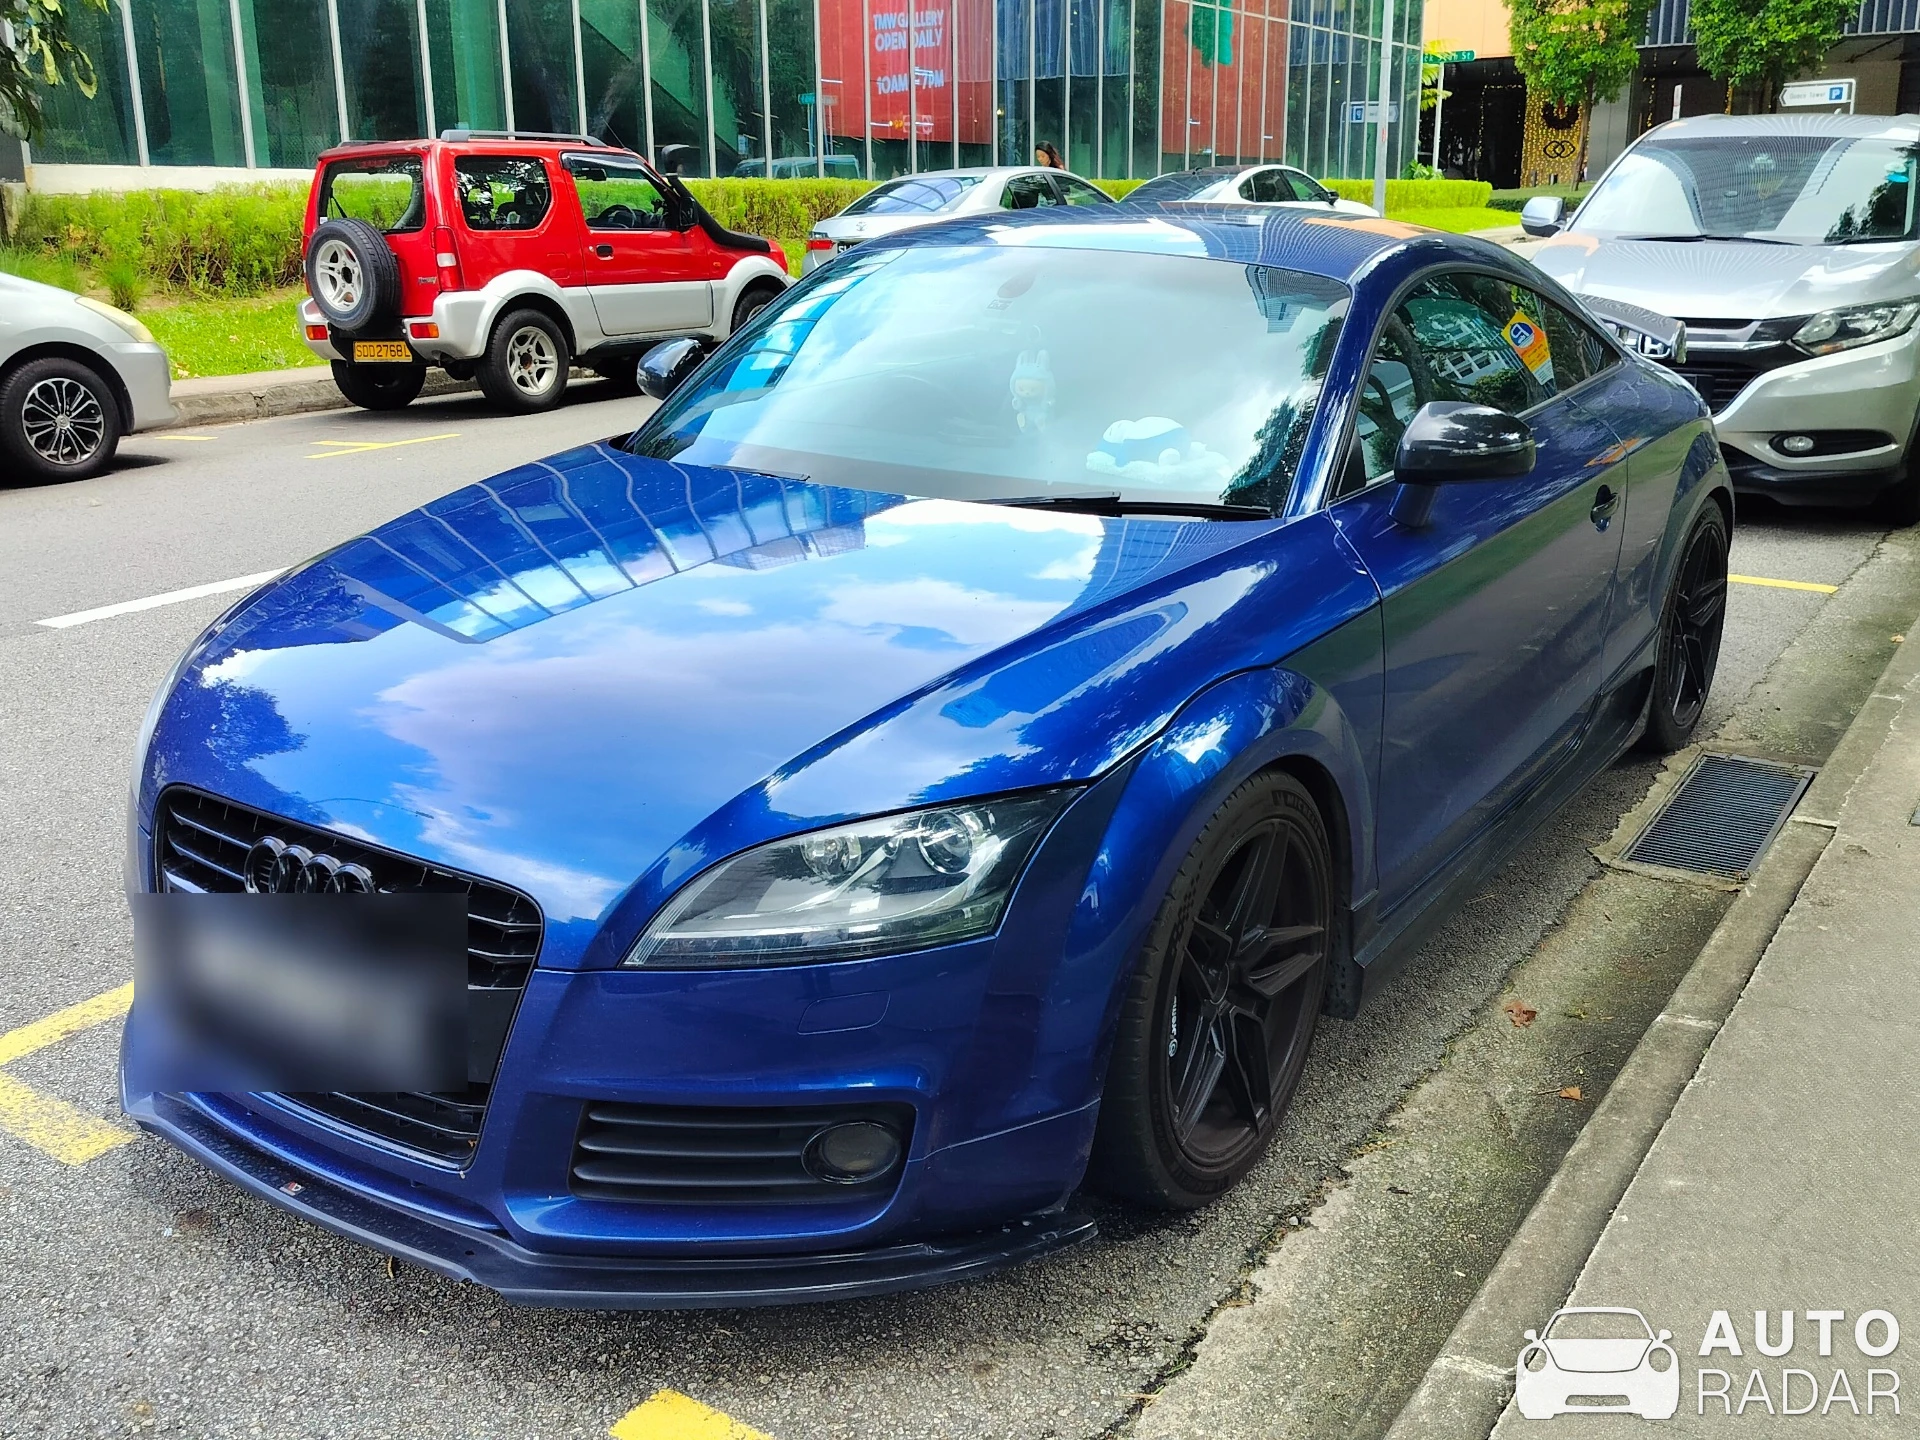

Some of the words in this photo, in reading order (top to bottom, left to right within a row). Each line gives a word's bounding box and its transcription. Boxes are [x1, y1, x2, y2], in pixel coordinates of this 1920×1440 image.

[873, 12, 897, 30] TMW
[897, 10, 944, 28] GLLERY
[875, 31, 907, 52] OPEN
[913, 28, 943, 48] DAILY
[876, 73, 909, 95] 10AM
[356, 344, 411, 358] SDD2768L
